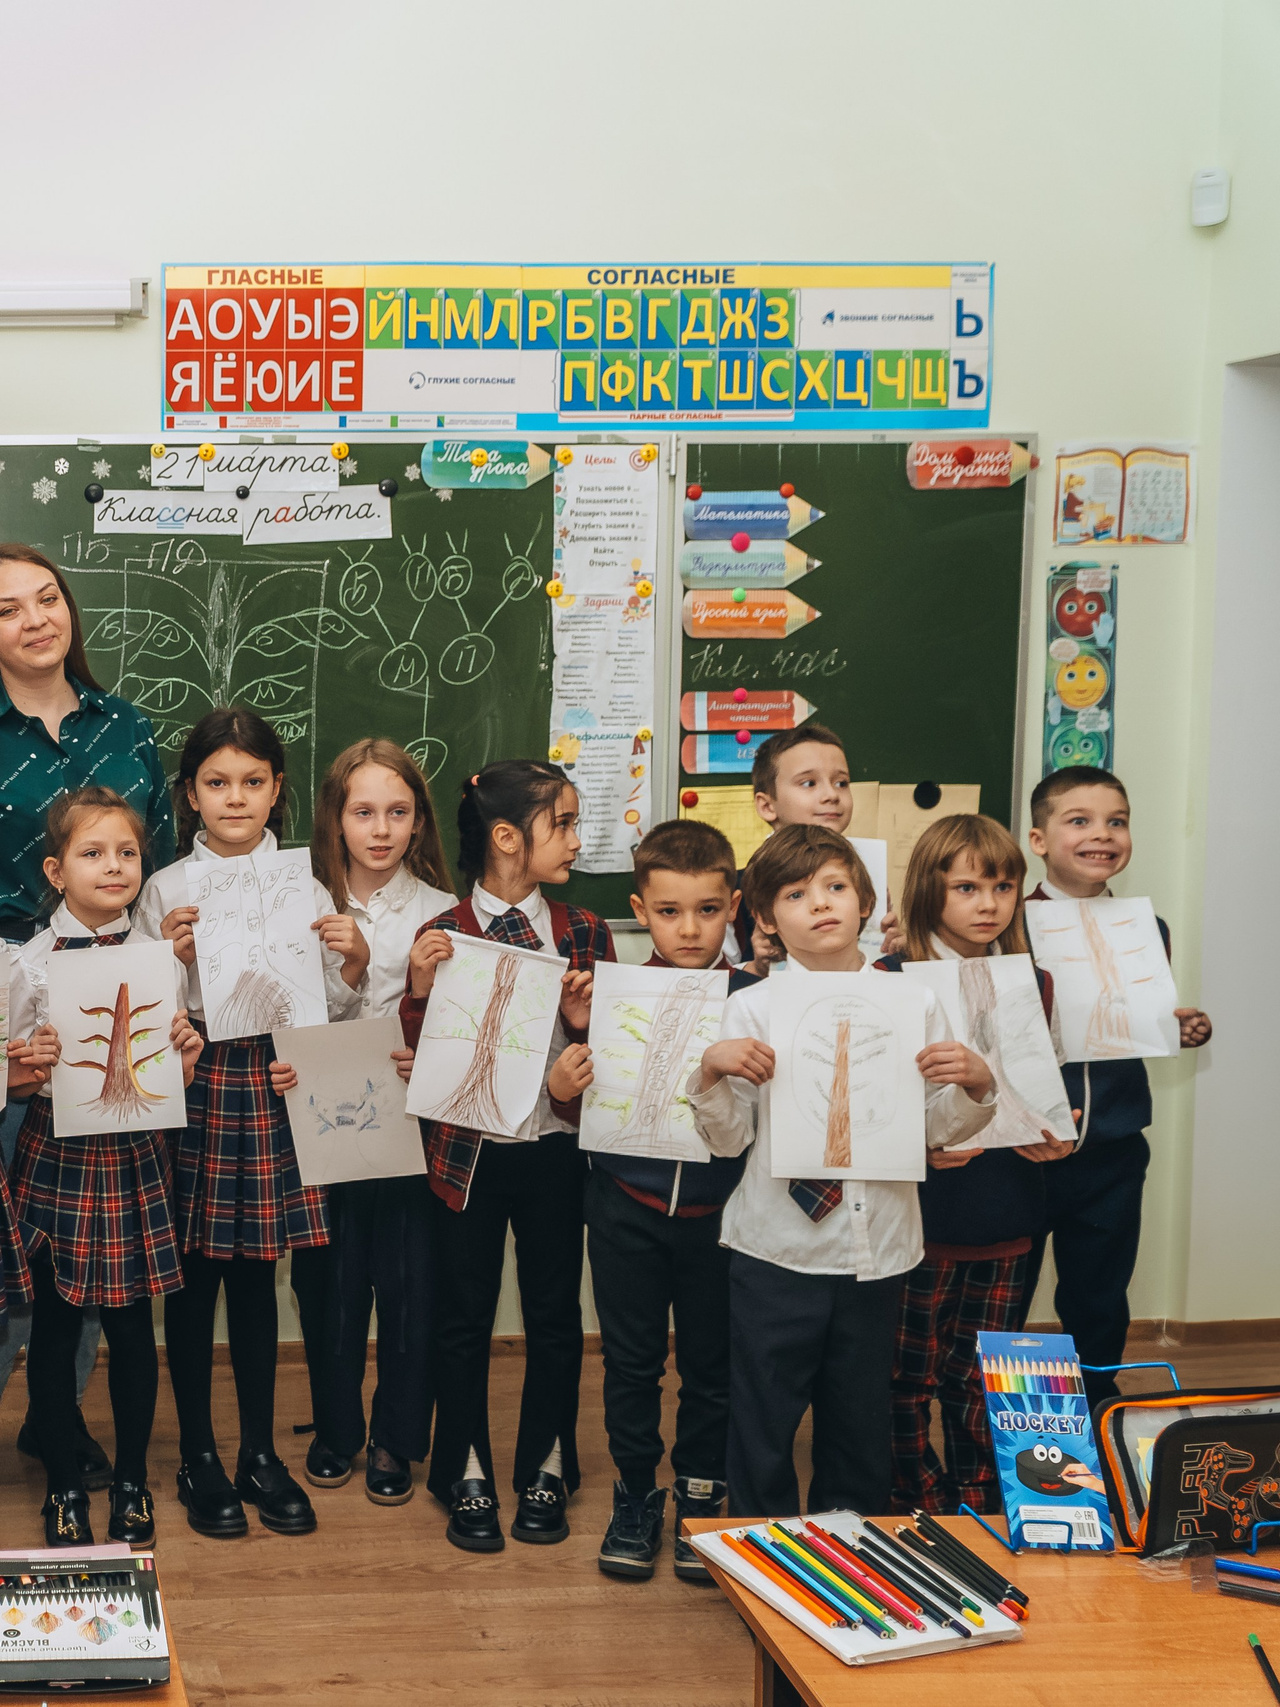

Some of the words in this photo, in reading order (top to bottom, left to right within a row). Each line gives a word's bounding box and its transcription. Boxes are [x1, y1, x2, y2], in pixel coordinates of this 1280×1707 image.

[207, 269, 324, 286] ГЛАСНЫЕ
[587, 268, 736, 286] СОГЛАСНЫЕ
[839, 312, 878, 322] ЗВОНКИЕ
[881, 312, 935, 322] СОГЛАСНЫЕ
[427, 377, 460, 385] ГЛУХИЕ
[463, 376, 516, 385] СОГЛАСНЫЕ
[629, 412, 667, 420] ПАРНЫЕ
[669, 411, 724, 420] СОГЛАСНЫЕ
[437, 440, 501, 463] Теа
[585, 454, 617, 466] Цель:
[157, 451, 199, 480] 21
[470, 461, 531, 483] урока
[930, 464, 1011, 486] задание
[97, 496, 239, 524] Классная
[692, 505, 791, 522] Математика
[691, 555, 788, 577] Физкультура
[692, 601, 749, 624] Русский
[752, 605, 788, 624] язык
[708, 700, 792, 712] Литературное
[729, 713, 770, 722] чтение
[568, 731, 634, 744] Рефлексия
[997, 1410, 1085, 1435] HOCKEY
